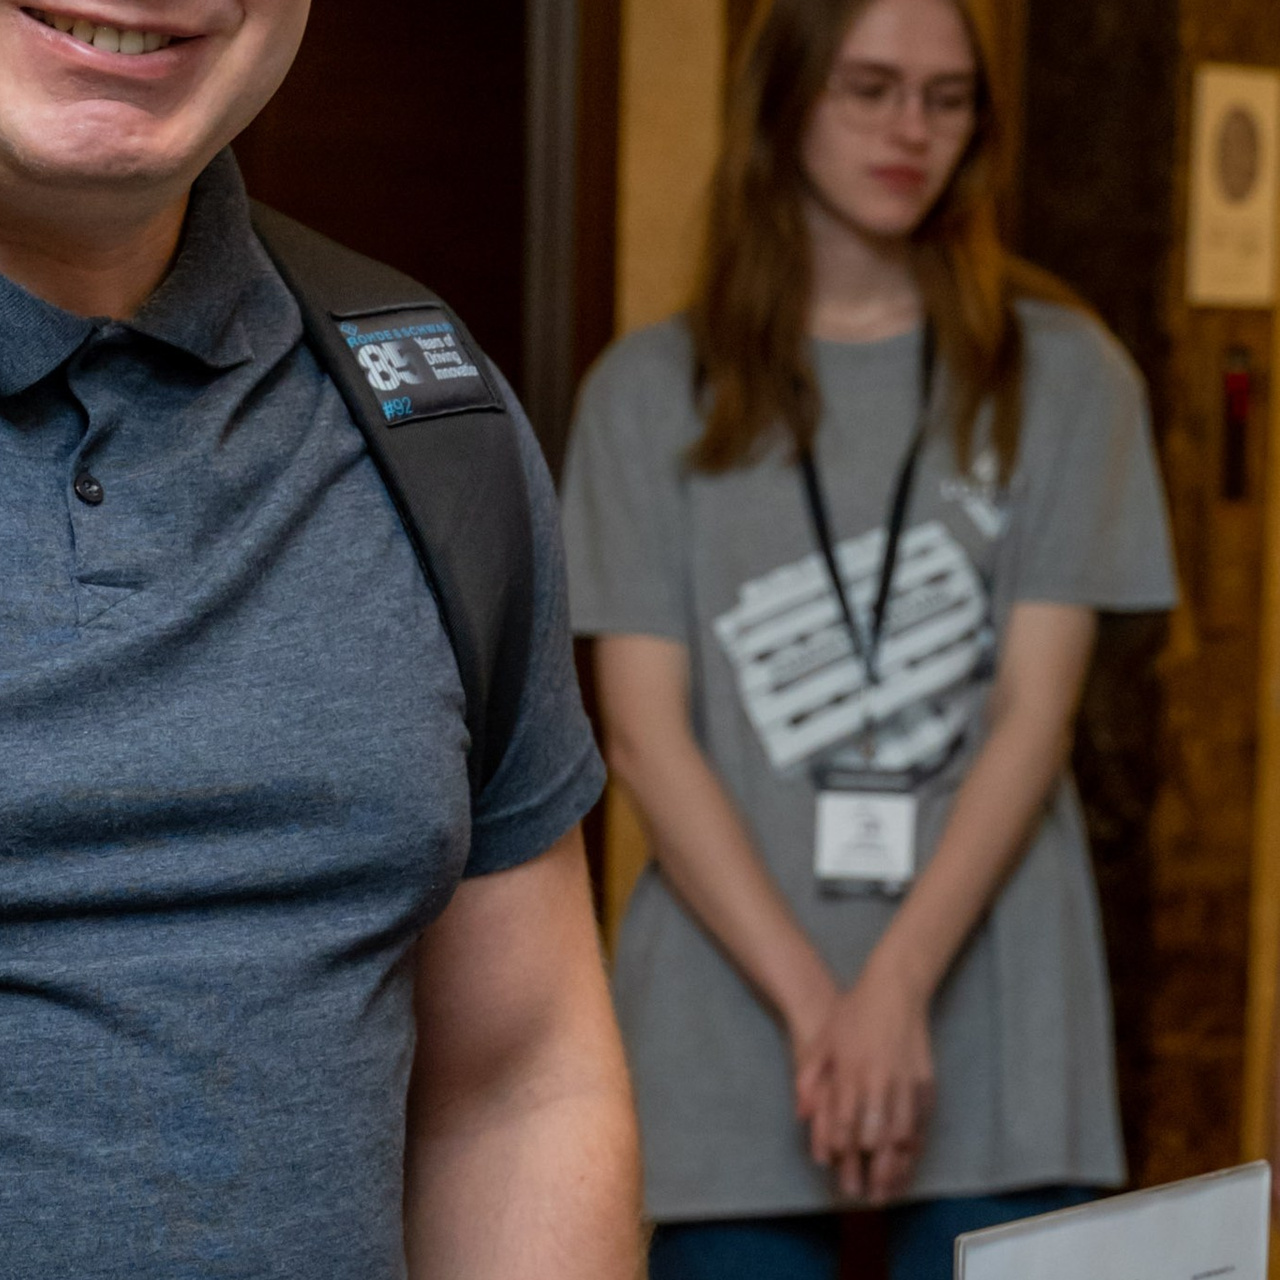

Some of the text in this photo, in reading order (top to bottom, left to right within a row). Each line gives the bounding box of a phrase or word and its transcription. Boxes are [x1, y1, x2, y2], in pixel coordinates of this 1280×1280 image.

[413, 333, 456, 350] Years of
[358, 340, 423, 391] 85
[423, 349, 463, 365] Driving
[382, 396, 413, 420] #92
